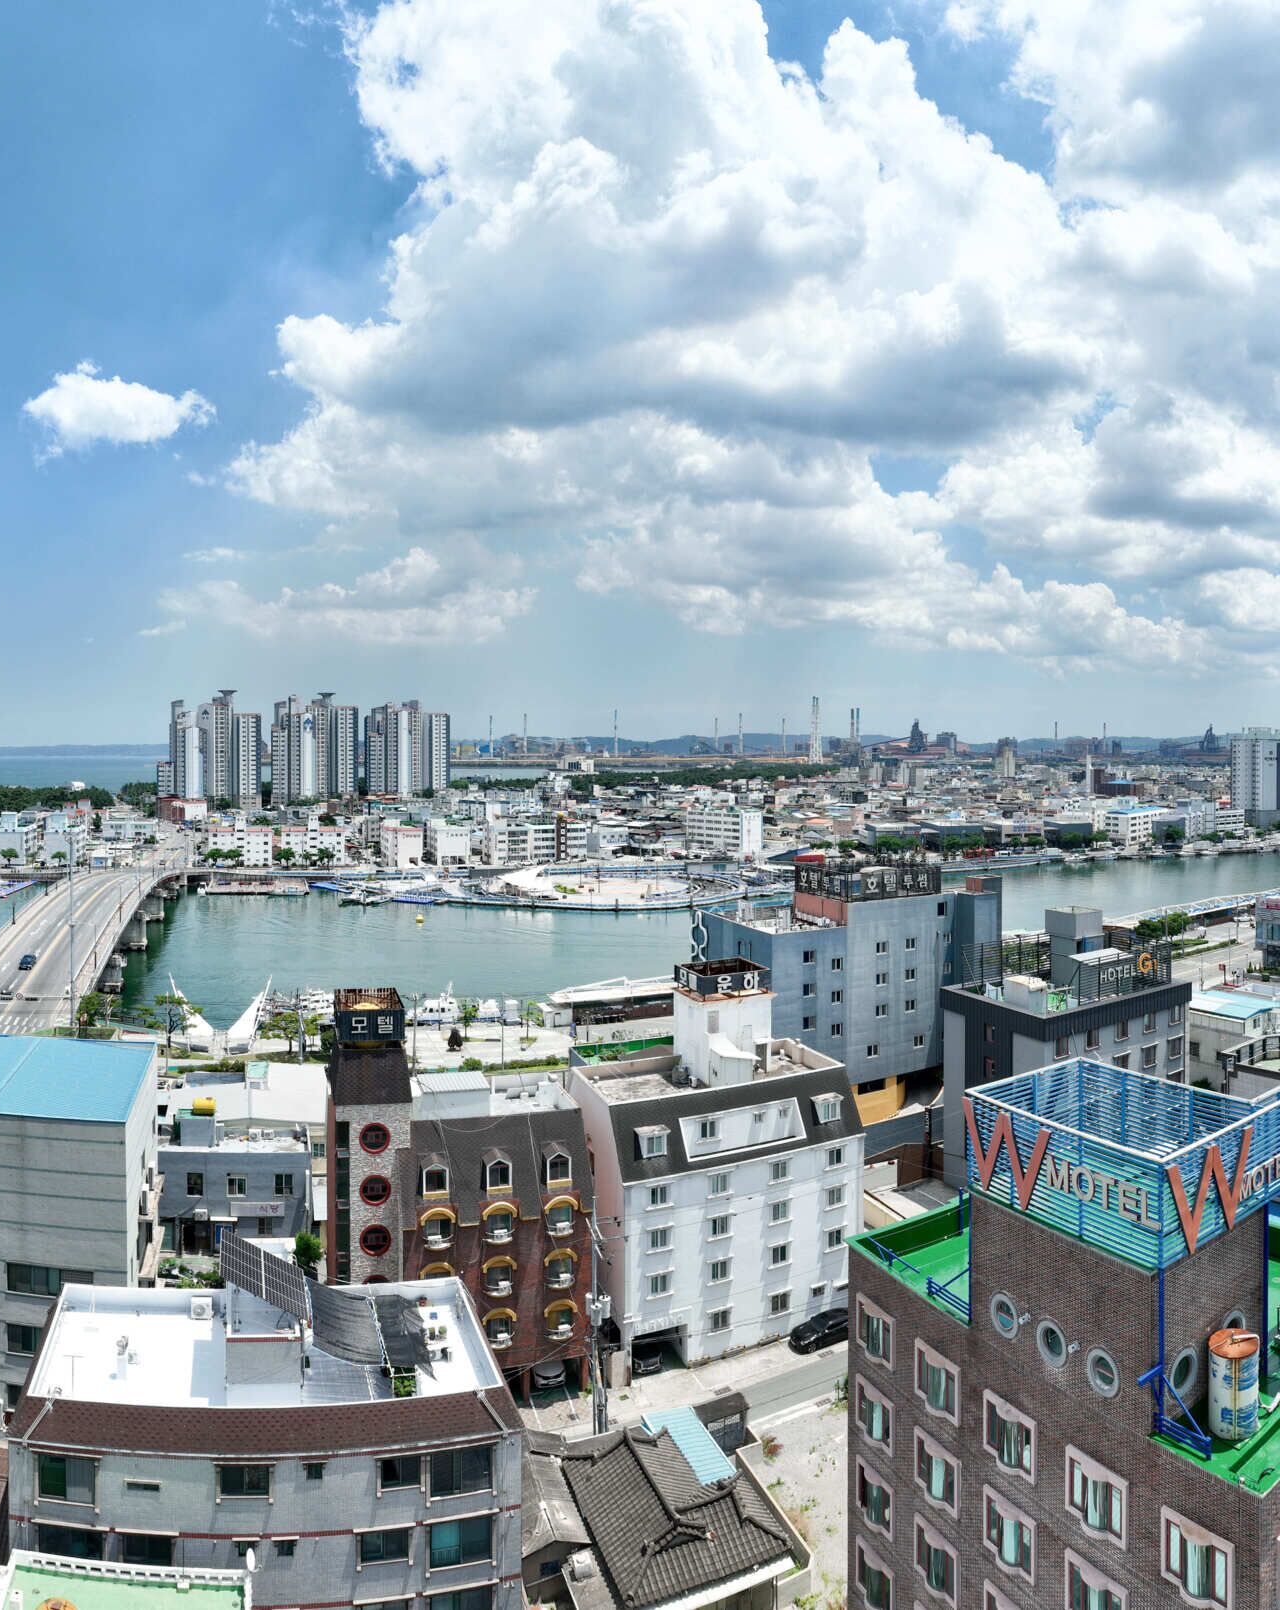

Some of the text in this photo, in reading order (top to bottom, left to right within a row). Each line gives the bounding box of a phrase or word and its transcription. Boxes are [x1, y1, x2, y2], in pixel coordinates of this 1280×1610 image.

[717, 971, 760, 993] 운하
[1100, 964, 1137, 984] HOTEL
[351, 1015, 394, 1034] 모텔
[961, 1096, 1162, 1232] W MOTEL
[1164, 1125, 1255, 1254] W
